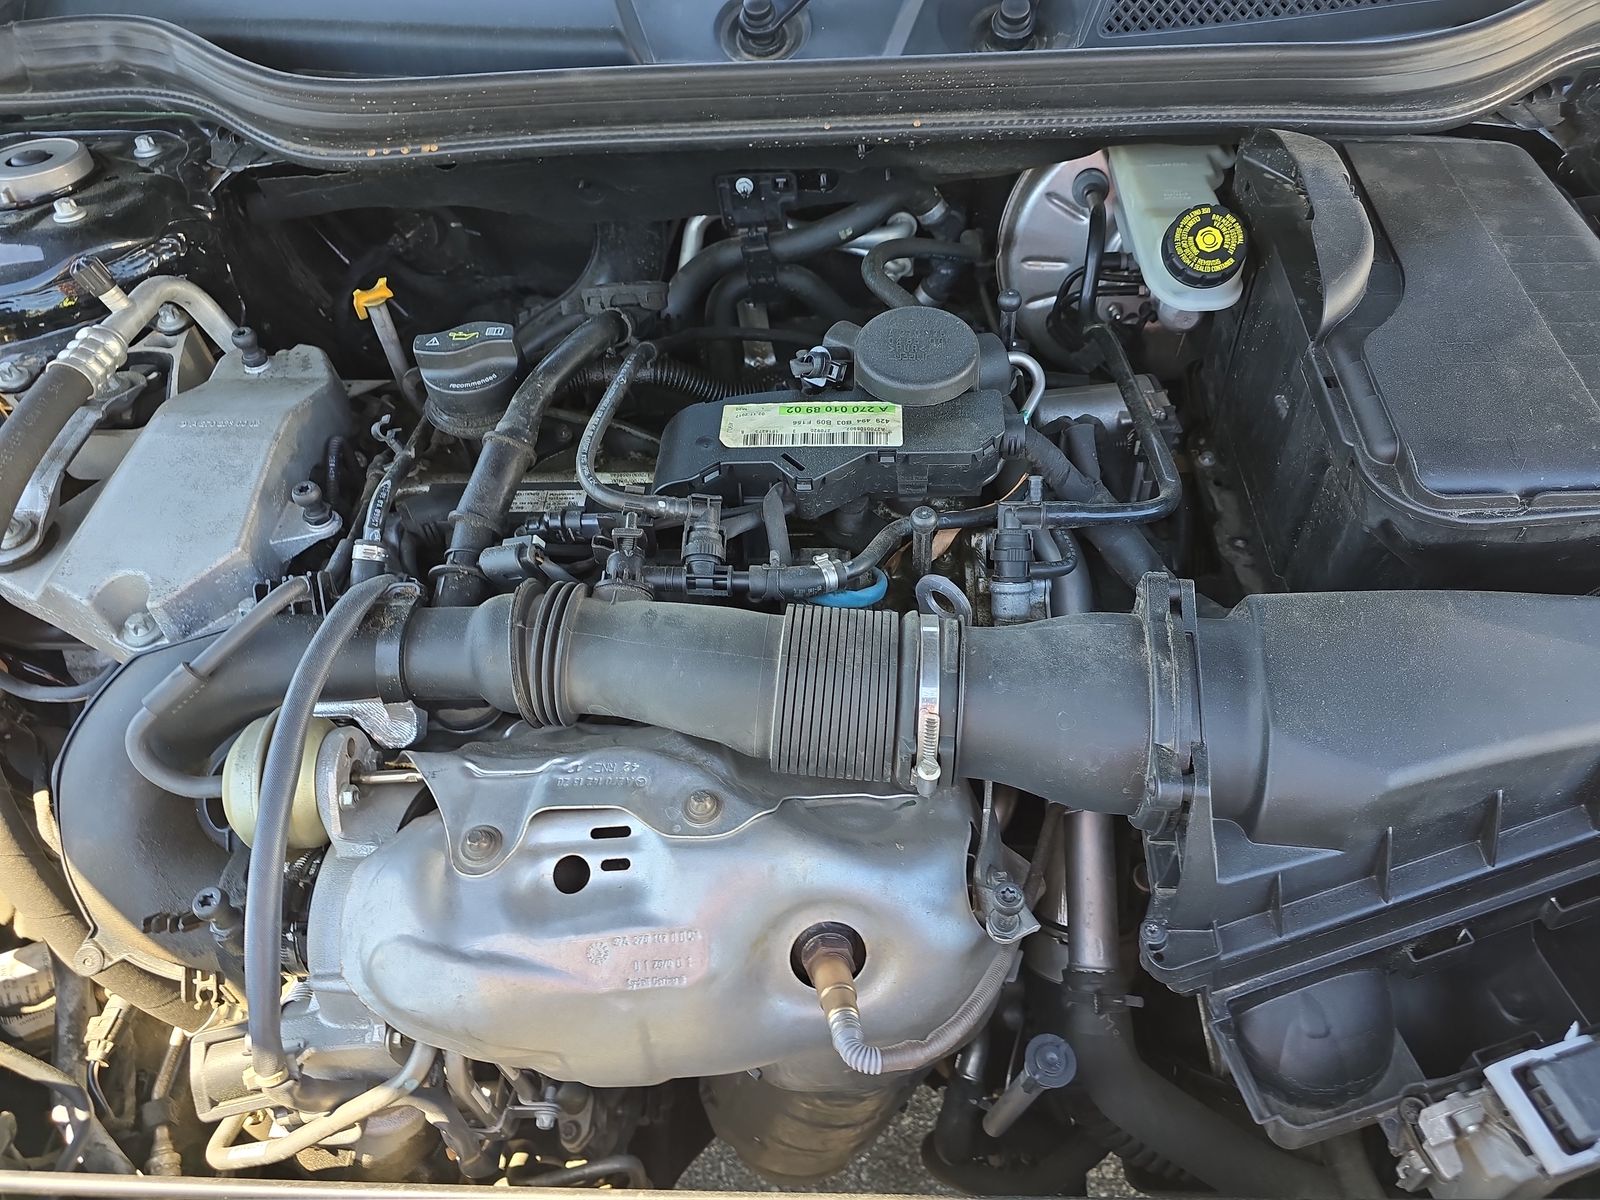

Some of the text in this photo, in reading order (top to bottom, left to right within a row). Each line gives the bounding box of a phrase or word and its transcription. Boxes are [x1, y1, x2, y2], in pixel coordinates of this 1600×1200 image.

[449, 373, 498, 389] recommended
[786, 406, 802, 414] 02
[805, 406, 820, 414] 89
